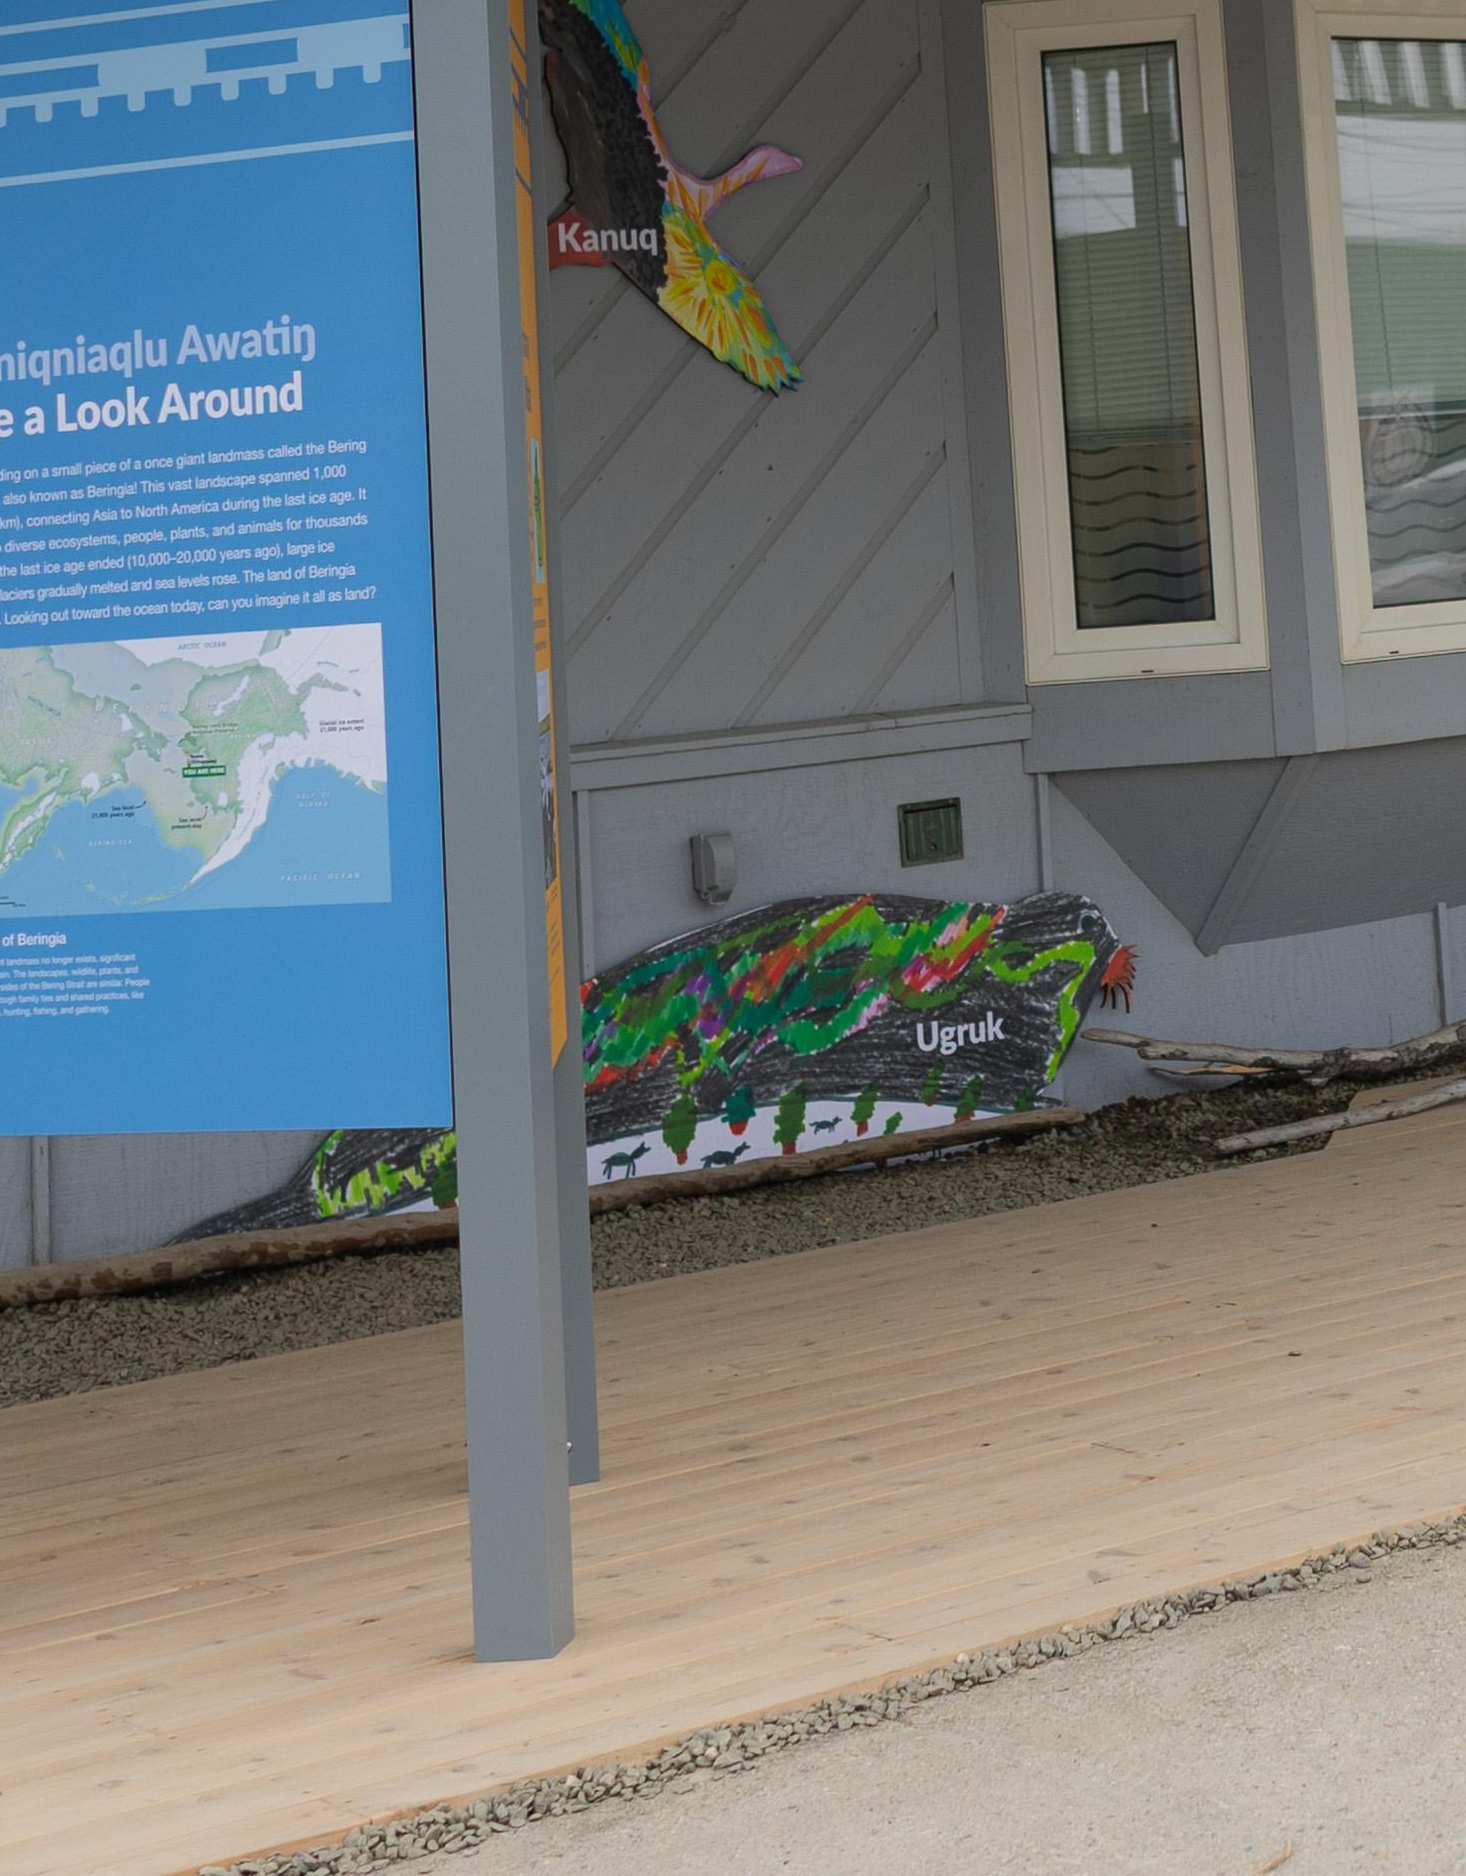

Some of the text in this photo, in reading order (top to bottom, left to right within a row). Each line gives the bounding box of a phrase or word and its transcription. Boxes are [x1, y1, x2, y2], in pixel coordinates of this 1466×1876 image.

[558, 222, 658, 256] Kanuq
[23, 405, 45, 436] a
[56, 386, 150, 433] Look
[158, 371, 303, 423] Around
[24, 469, 38, 479] on
[41, 467, 48, 477] a
[52, 463, 81, 476] small
[85, 461, 116, 476] piece
[119, 458, 130, 471] of
[134, 460, 141, 469] a
[144, 457, 173, 468] once
[176, 452, 204, 469] giant
[208, 449, 264, 463] landmass
[267, 444, 302, 458] called
[305, 443, 324, 455] the
[328, 440, 366, 453] Bering
[3, 492, 26, 504] also
[29, 490, 67, 502] known
[70, 489, 84, 499] as
[87, 482, 137, 498] Beringia!
[140, 480, 165, 492] This
[168, 478, 192, 490] vast
[195, 474, 256, 488] landscape
[258, 467, 309, 485] spanned
[313, 464, 346, 479] 1,000
[0, 516, 23, 530] km),
[26, 511, 89, 526] connecting
[93, 508, 117, 521] Asia
[120, 508, 132, 519] to
[135, 504, 168, 517] North
[171, 501, 219, 514] America
[222, 497, 259, 511] during
[262, 495, 281, 507] the
[285, 493, 305, 505] last
[309, 492, 326, 504] ice
[329, 491, 354, 505] age.
[359, 487, 366, 499] It
[4, 540, 45, 552] diverse
[48, 534, 120, 549] ecosystems,
[124, 529, 166, 545] people,
[170, 526, 208, 542] plants,
[212, 522, 234, 536] and
[238, 519, 283, 534] animals
[286, 518, 302, 530] for
[305, 513, 368, 529] thousands
[0, 564, 17, 576] the
[20, 563, 40, 575] last
[44, 562, 60, 573] ice
[63, 561, 85, 574] age
[87, 556, 124, 570] ended
[127, 548, 216, 569] (10,000–20,000
[219, 548, 251, 563] years
[254, 544, 283, 560] ago),
[287, 543, 315, 557] large
[317, 541, 334, 553] ice
[37, 583, 87, 601] gradually
[90, 580, 128, 593] melted
[130, 578, 152, 591] and
[154, 579, 175, 589] sea
[178, 574, 209, 588] levels
[212, 574, 239, 585] rose.
[242, 570, 264, 582] The
[267, 568, 291, 581] land
[294, 567, 306, 579] of
[309, 564, 356, 579] Beringia
[4, 611, 48, 624] Looking
[50, 609, 68, 620] out
[71, 605, 110, 618] toward
[112, 604, 131, 616] the
[133, 603, 168, 615] ocean
[170, 599, 204, 614] today,
[208, 599, 228, 610] can
[231, 598, 252, 611] you
[255, 593, 300, 608] imagine
[302, 591, 309, 602] it
[312, 589, 325, 602] all
[328, 591, 342, 601] as
[345, 585, 376, 600] land?
[2, 933, 14, 946] of
[18, 932, 66, 947] Beringia
[916, 1010, 1005, 1055] Ugruk
